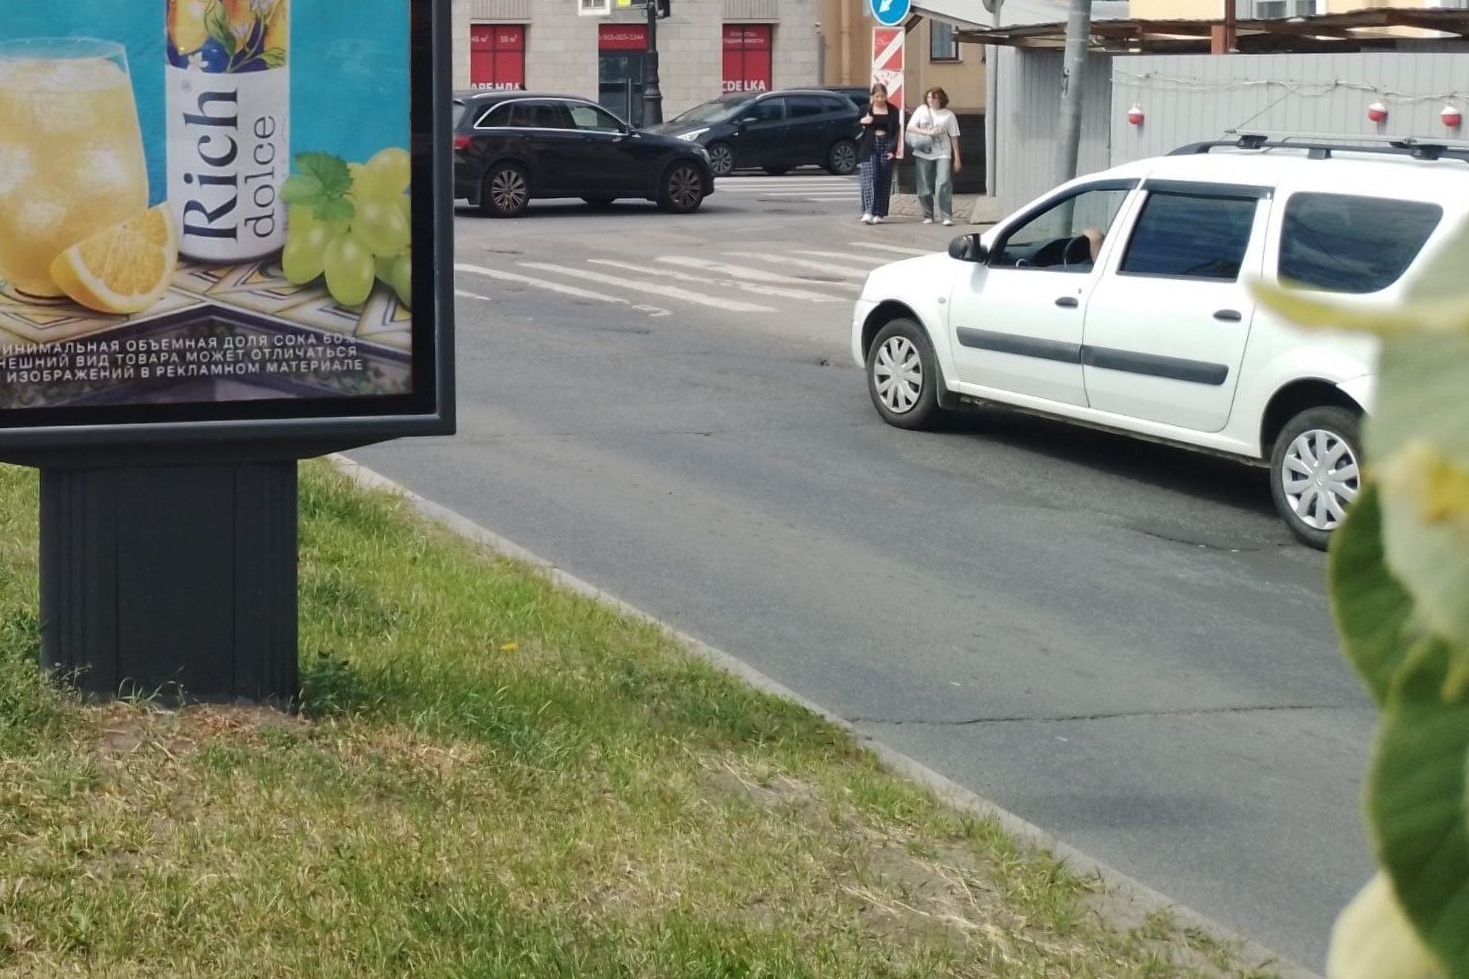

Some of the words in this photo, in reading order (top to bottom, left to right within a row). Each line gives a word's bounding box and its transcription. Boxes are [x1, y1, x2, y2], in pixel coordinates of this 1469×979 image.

[183, 87, 238, 244] Rich
[244, 115, 276, 239] dolce
[126, 337, 218, 353] ОБЪЕМНАЯ
[223, 335, 268, 349] ДОЛЯ
[273, 333, 317, 346] СОКА
[323, 331, 357, 345] 60%
[75, 353, 109, 367] ВИД
[115, 351, 180, 365] ТОВАРА
[186, 348, 245, 363] МОЖЕТ
[250, 345, 357, 361] ОТЛИЧАТЬСЯ
[6, 365, 134, 382] ИЗОБРАЖЕНИЙ
[140, 366, 150, 378] В
[156, 362, 260, 377] РЕКЛАМНОМ
[266, 358, 363, 374] МАТЕРИАЛЕ
